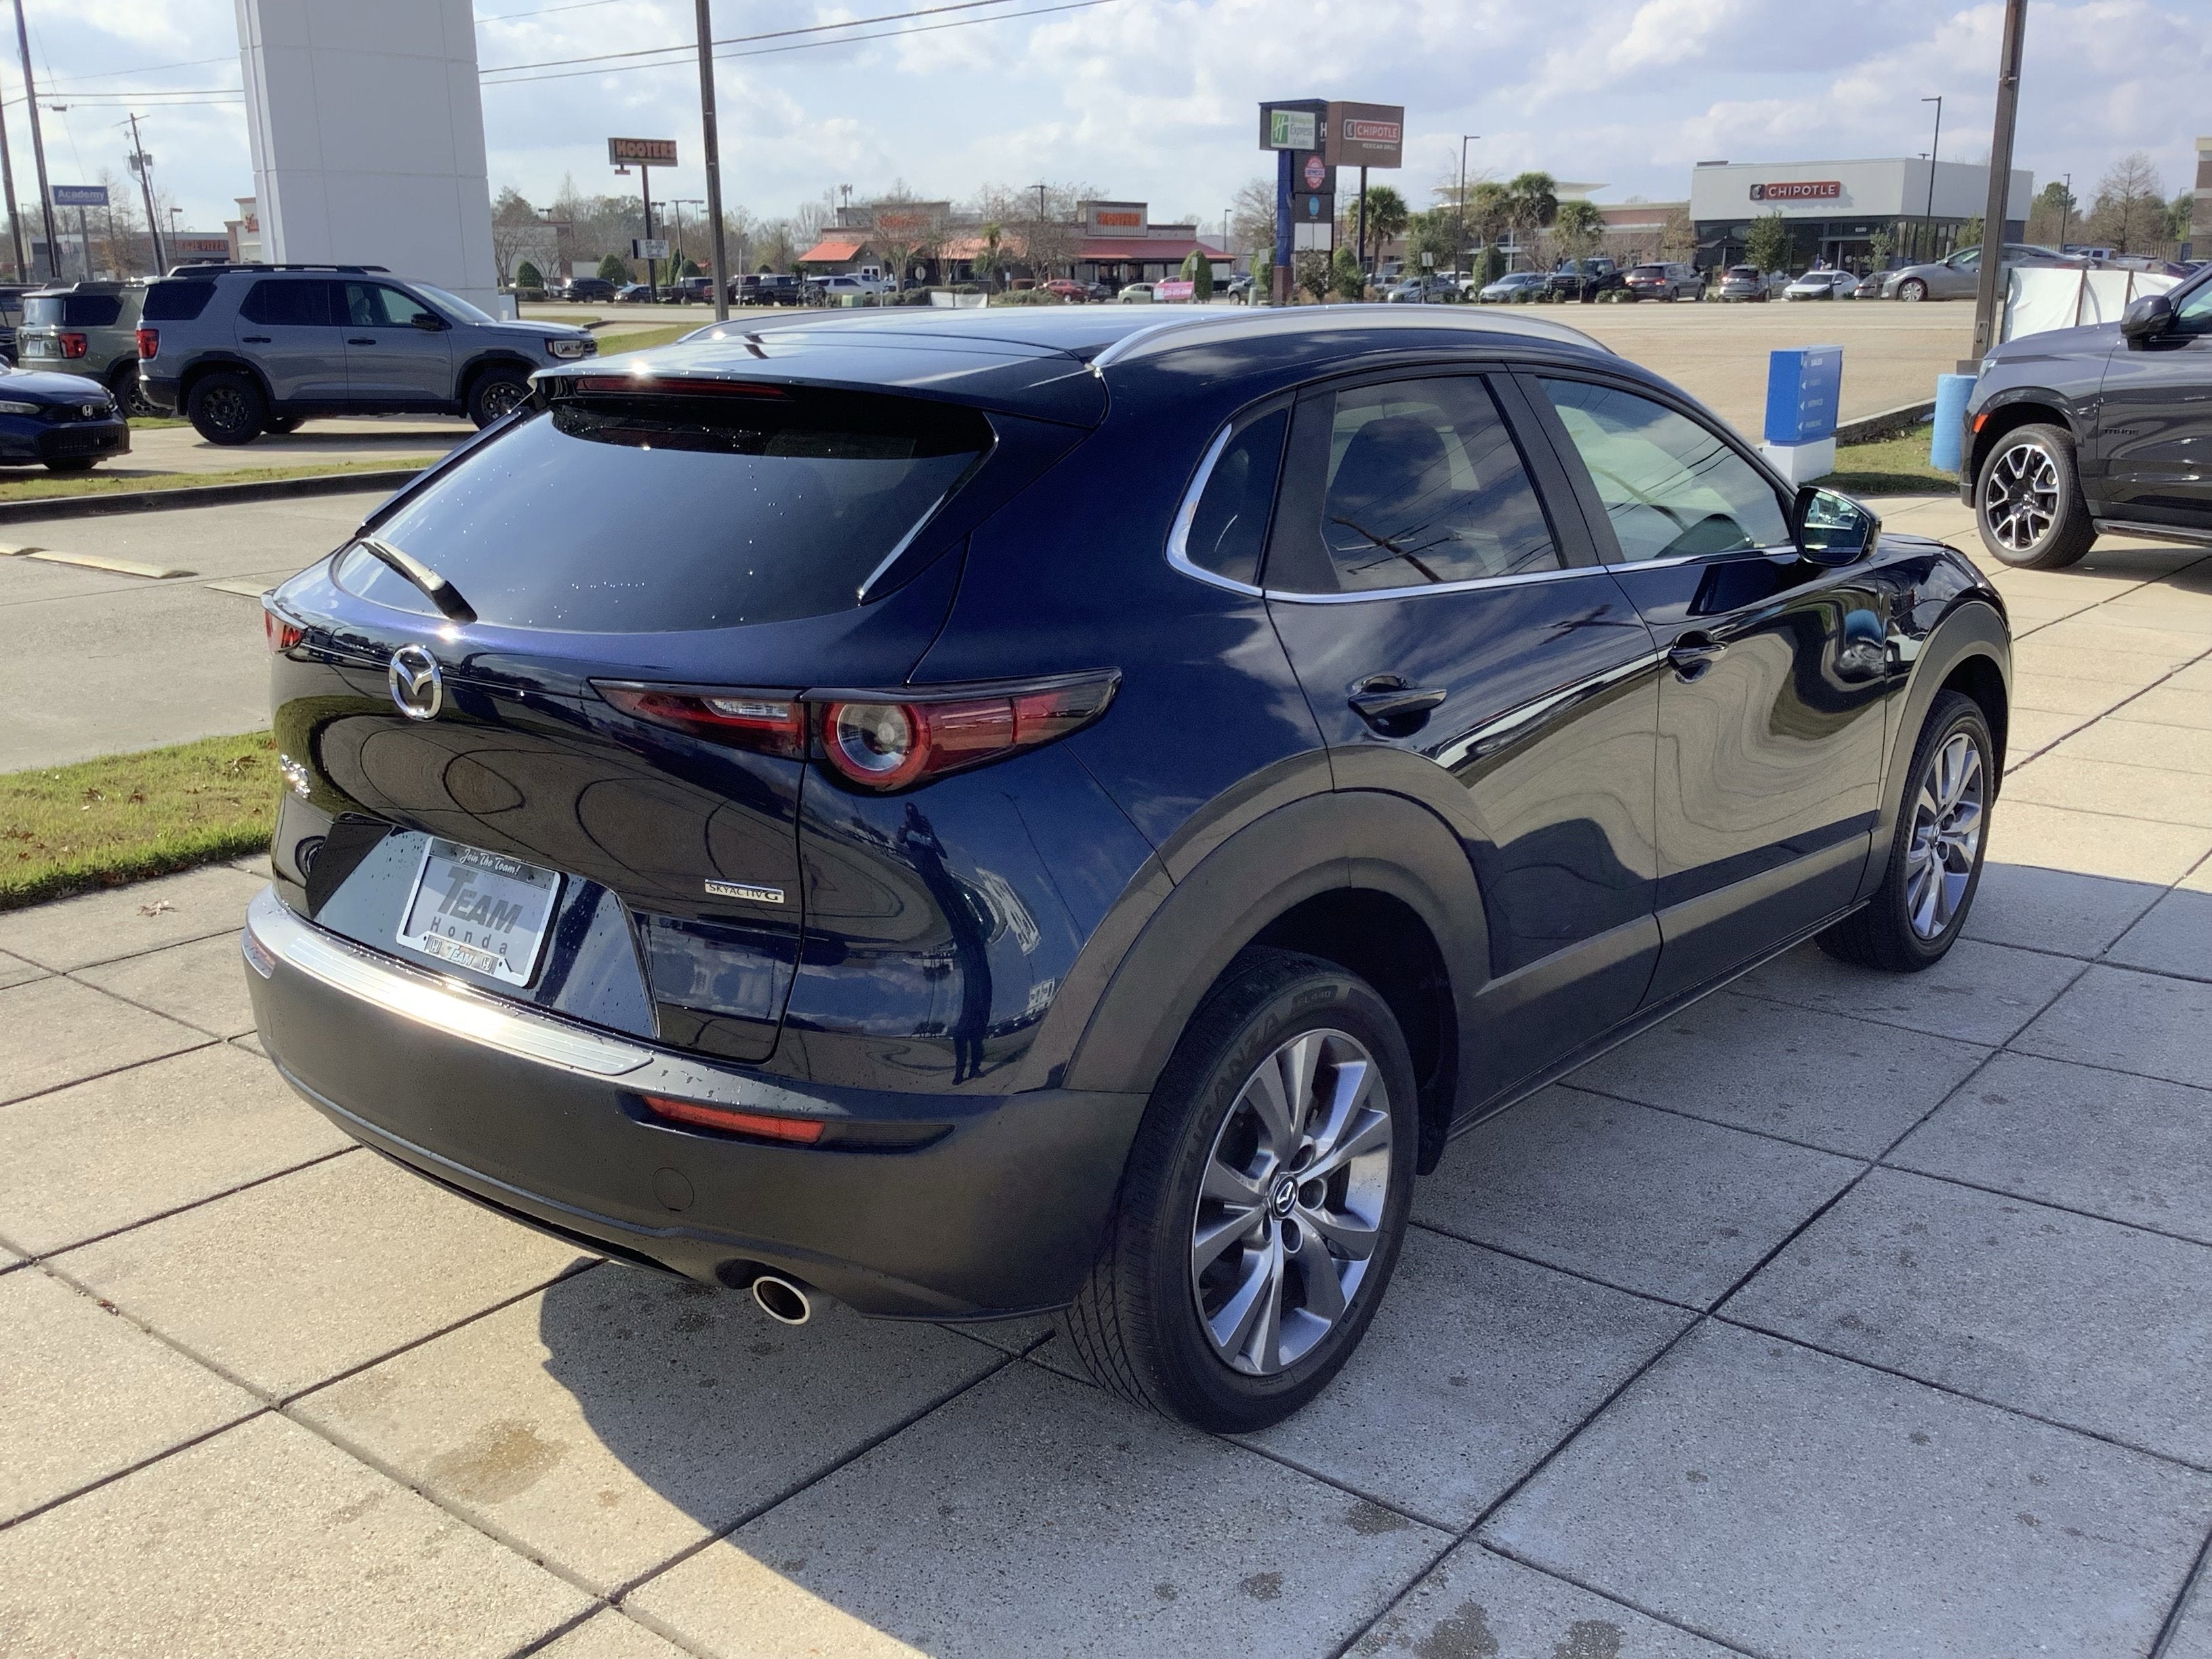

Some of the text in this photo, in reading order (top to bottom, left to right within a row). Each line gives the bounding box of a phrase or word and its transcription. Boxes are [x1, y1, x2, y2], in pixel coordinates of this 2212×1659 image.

[1357, 125, 1397, 138] CHIPOTLE
[615, 140, 677, 158] HOOTERS
[58, 189, 105, 201] Academy
[1768, 184, 1837, 197] CHIPOTLE
[459, 848, 521, 876] Join The Team!
[438, 865, 523, 934] TEAM
[430, 916, 508, 956] Honda
[447, 943, 474, 966] TEAM
